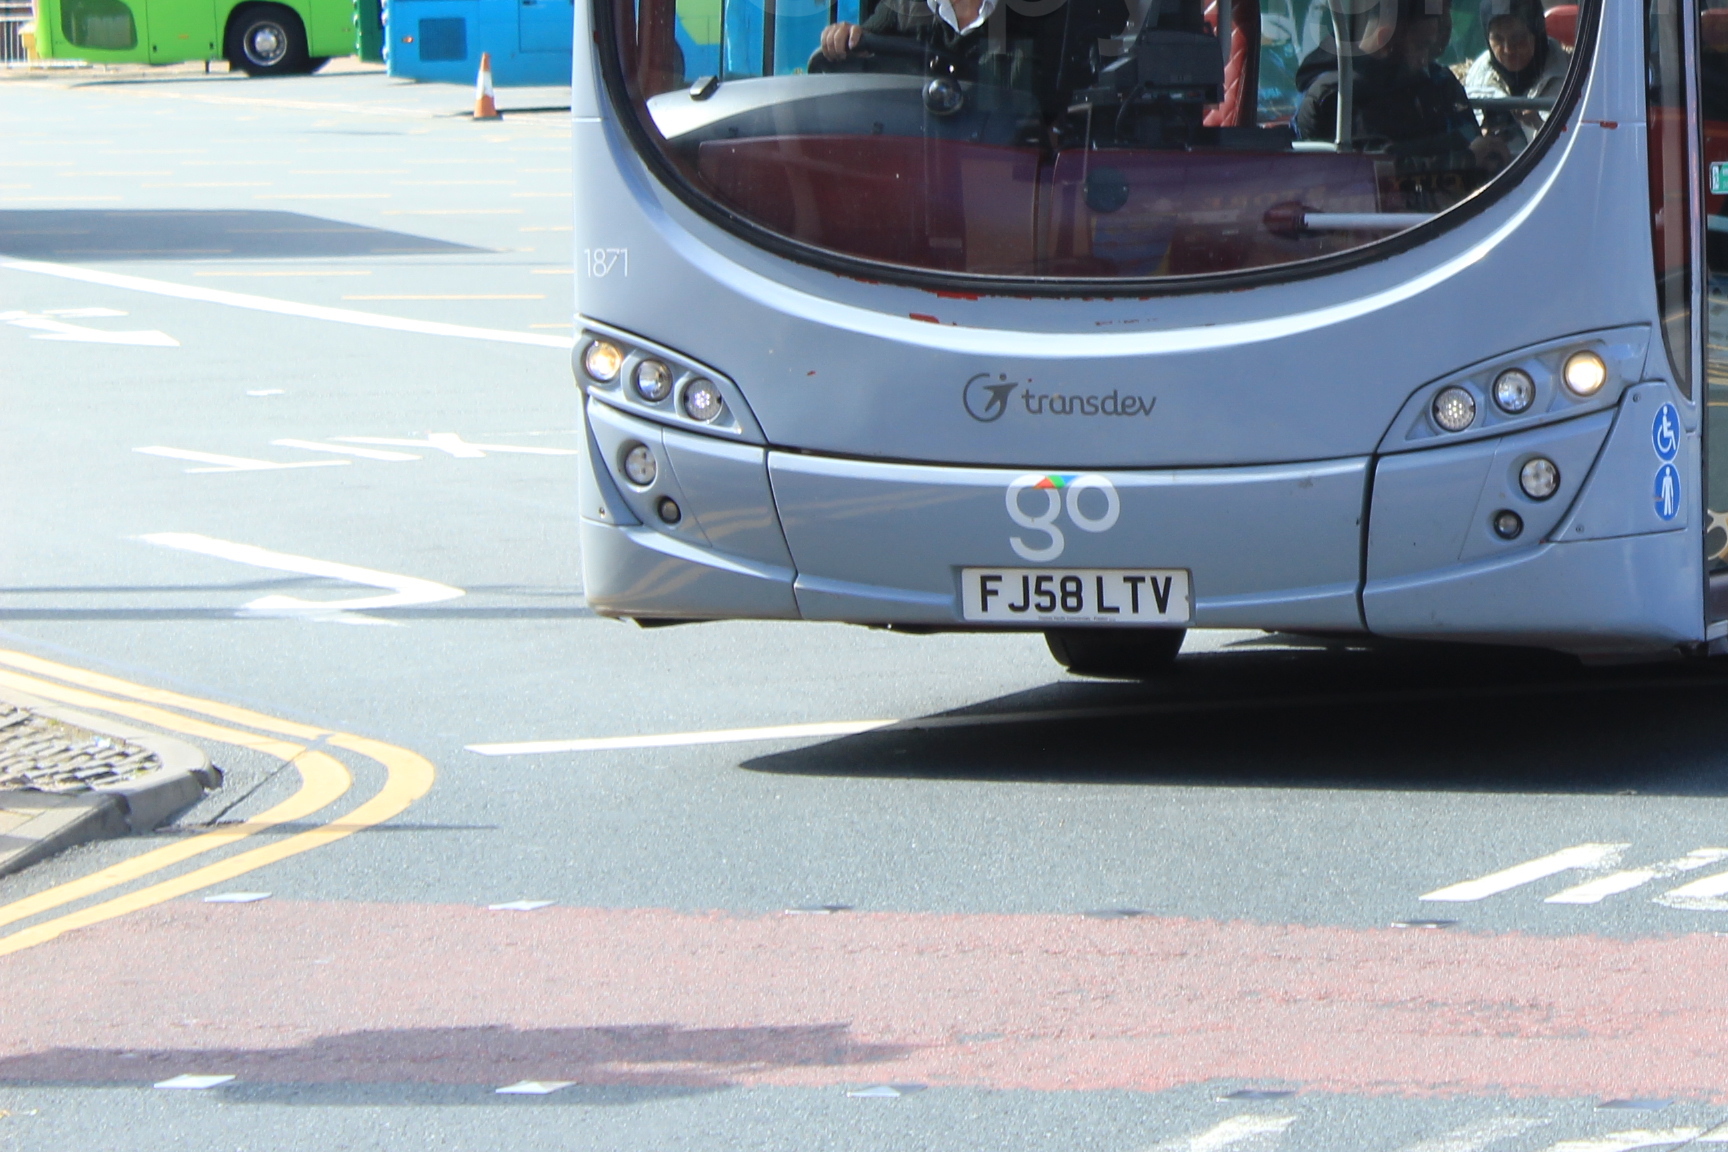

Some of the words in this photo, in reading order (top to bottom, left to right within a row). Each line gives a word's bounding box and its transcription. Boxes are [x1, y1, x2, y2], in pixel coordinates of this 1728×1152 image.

[584, 247, 629, 278] 1871
[1021, 388, 1157, 417] transdev
[1005, 474, 1121, 562] go
[980, 574, 1084, 614] FJ58
[1096, 575, 1172, 615] LTV
